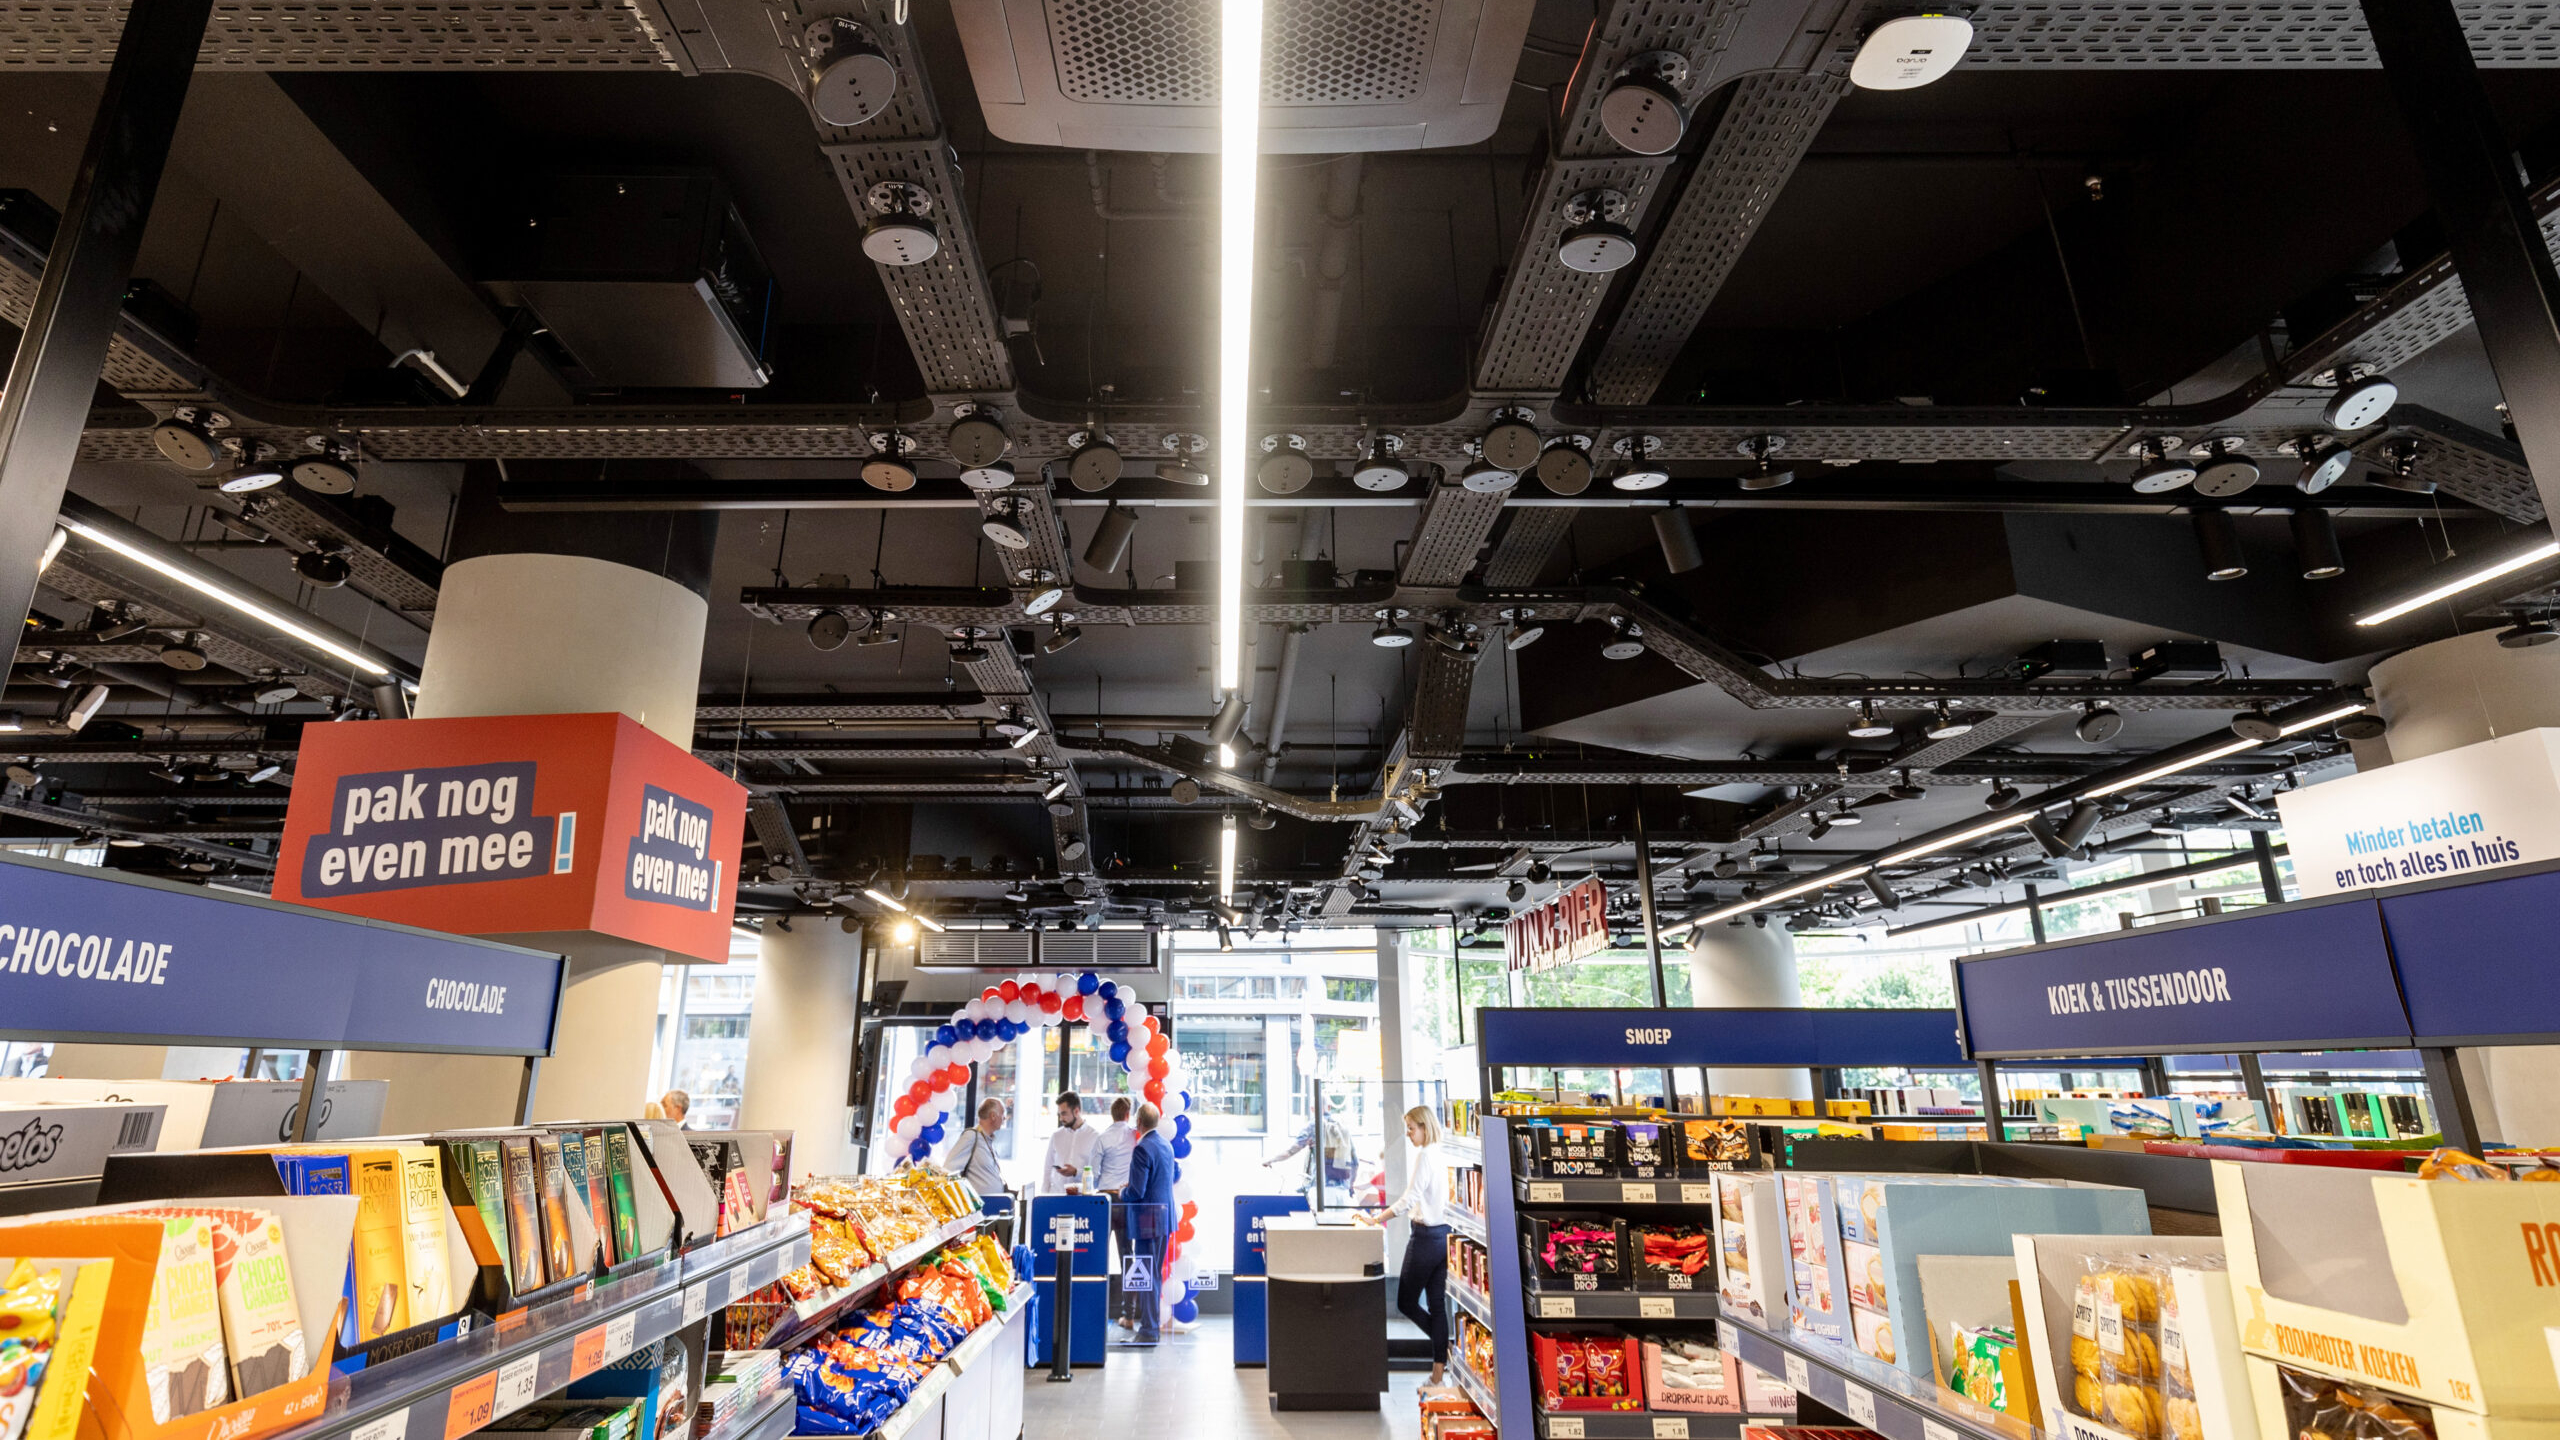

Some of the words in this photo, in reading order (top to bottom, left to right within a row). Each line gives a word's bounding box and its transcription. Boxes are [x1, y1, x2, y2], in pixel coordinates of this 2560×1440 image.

[343, 773, 430, 836] pak
[437, 772, 519, 826] nog
[643, 795, 676, 839] pak
[678, 811, 708, 860] nog
[2345, 826, 2406, 857] Minder
[2409, 808, 2485, 845] betalen
[319, 834, 427, 887] even
[436, 829, 535, 875] mee
[2335, 867, 2356, 889] en
[2358, 856, 2398, 885] toch
[2401, 847, 2448, 877] alles
[2448, 846, 2471, 871] in
[2474, 836, 2520, 866] huis
[632, 850, 675, 894] even
[676, 861, 709, 903] mee
[1503, 909, 1543, 972] WIJN
[1558, 879, 1608, 945] BIER
[0, 923, 173, 986] CHOCOLADE
[425, 976, 506, 1016] CHOCOLADE
[2048, 981, 2090, 1016] KOEK
[2092, 979, 2106, 1012] &
[2106, 967, 2231, 1011] TUSSENDOOR
[1625, 1028, 1672, 1045] SNOEP
[0, 1116, 60, 1172] etos
[478, 1162, 499, 1181] MOSER
[511, 1157, 531, 1176] MOSER
[545, 1167, 562, 1184] ROTH
[1553, 1161, 1584, 1175] DROP
[363, 1174, 394, 1194] MOSER
[408, 1170, 437, 1189] MOSER
[479, 1180, 501, 1198] ROTH
[512, 1174, 532, 1191] ROTH
[364, 1194, 395, 1214] ROTH
[410, 1188, 438, 1208] ROTH
[1043, 1232, 1056, 1243] en
[1246, 1232, 1259, 1243] en
[166, 1261, 213, 1294] CHOCO
[237, 1255, 287, 1288] CHOCO
[1574, 1281, 1598, 1291] DROP
[242, 1283, 290, 1311] CHANGER
[2075, 1304, 2093, 1323] SPRITS
[1814, 1322, 1841, 1337] YOGHURT
[2100, 1316, 2117, 1336] SPRITS
[620, 1331, 632, 1348] 1.35
[2164, 1328, 2180, 1349] SPRITS
[588, 1349, 602, 1368] 1.09
[2275, 1323, 2358, 1372] ROOMBOTER
[2358, 1343, 2422, 1390] KOEKEN
[2448, 1378, 2475, 1403] 18X
[517, 1375, 534, 1397] 1.35
[1661, 1391, 1704, 1405] DROPFRUIT
[1707, 1393, 1729, 1405] DUO'S
[470, 1402, 490, 1425] 1.09
[1568, 1428, 1582, 1436] 1.82
[1672, 1428, 1687, 1436] 1.81
